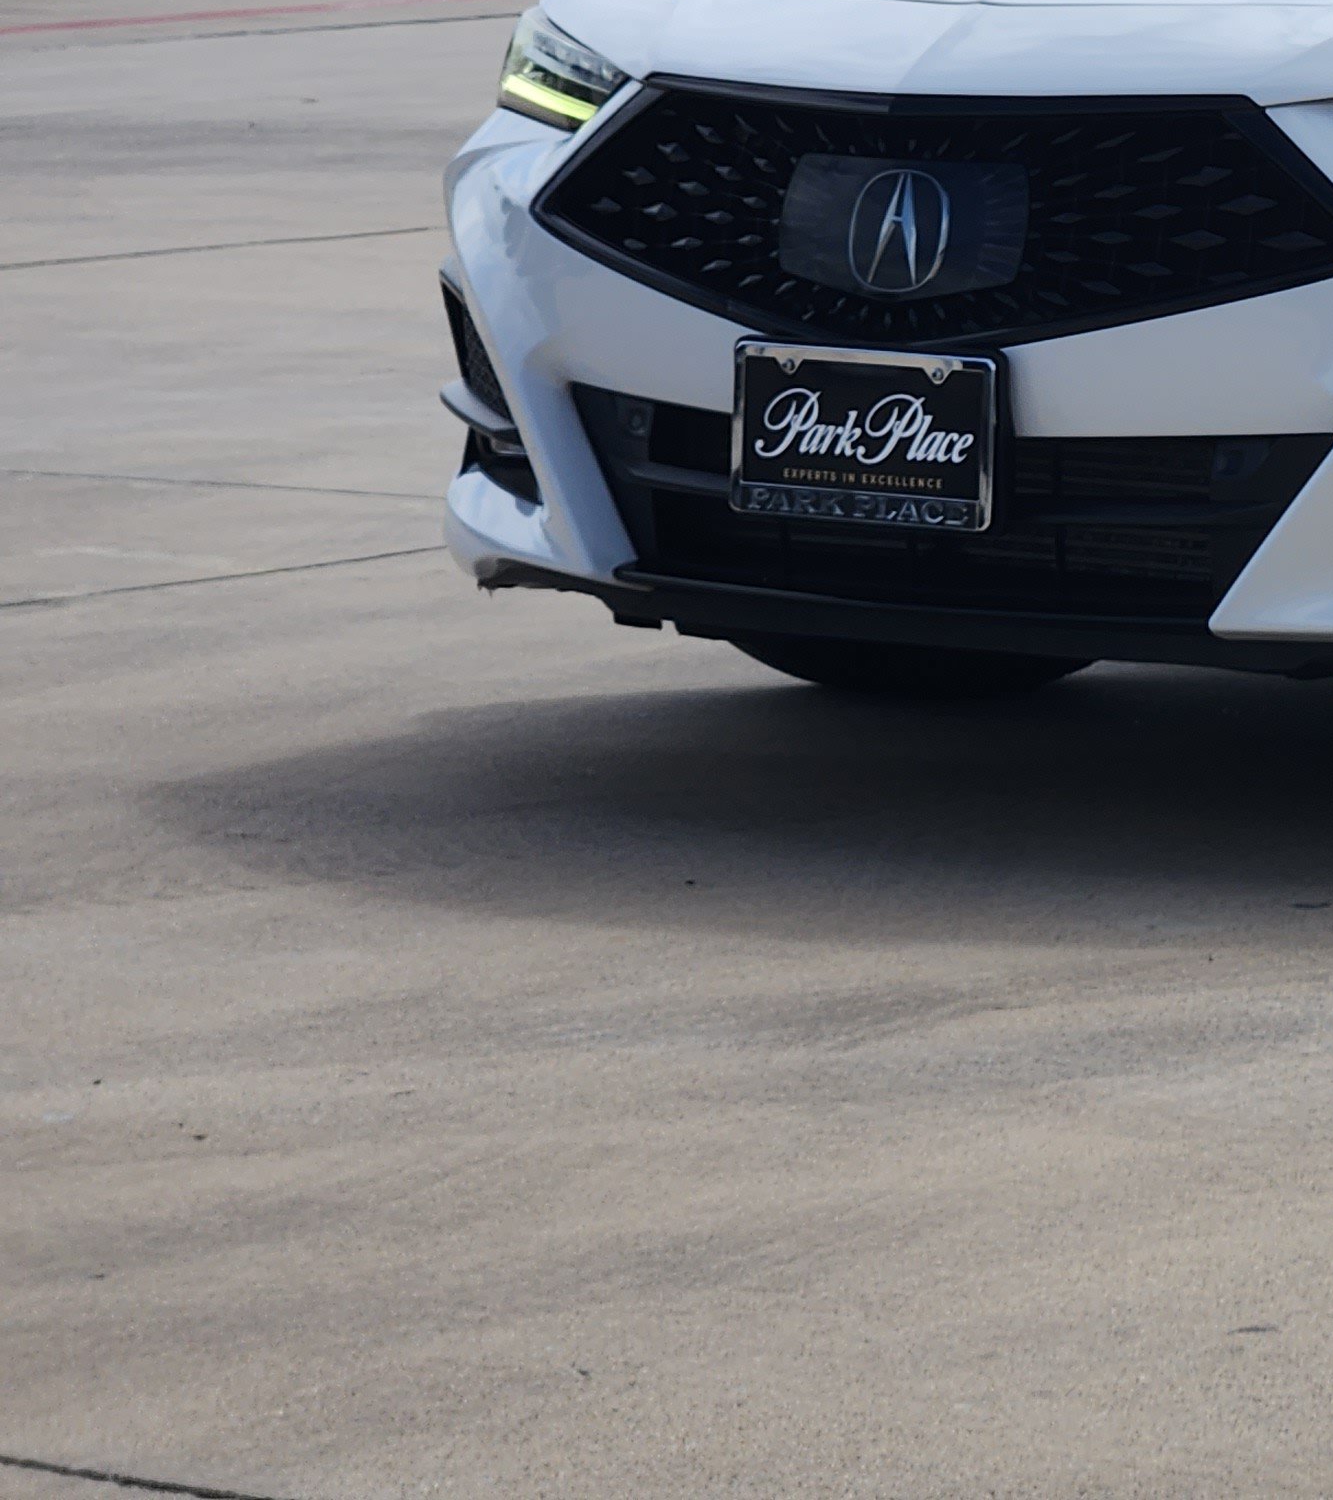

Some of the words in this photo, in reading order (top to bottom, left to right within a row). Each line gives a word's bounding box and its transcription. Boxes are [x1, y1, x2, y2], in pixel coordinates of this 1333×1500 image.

[755, 388, 862, 457] Park
[856, 394, 974, 464] Place
[783, 467, 837, 482] EXPERTS
[842, 473, 855, 483] IN
[862, 473, 943, 489] EXCELLENCE
[749, 487, 845, 515] PARK
